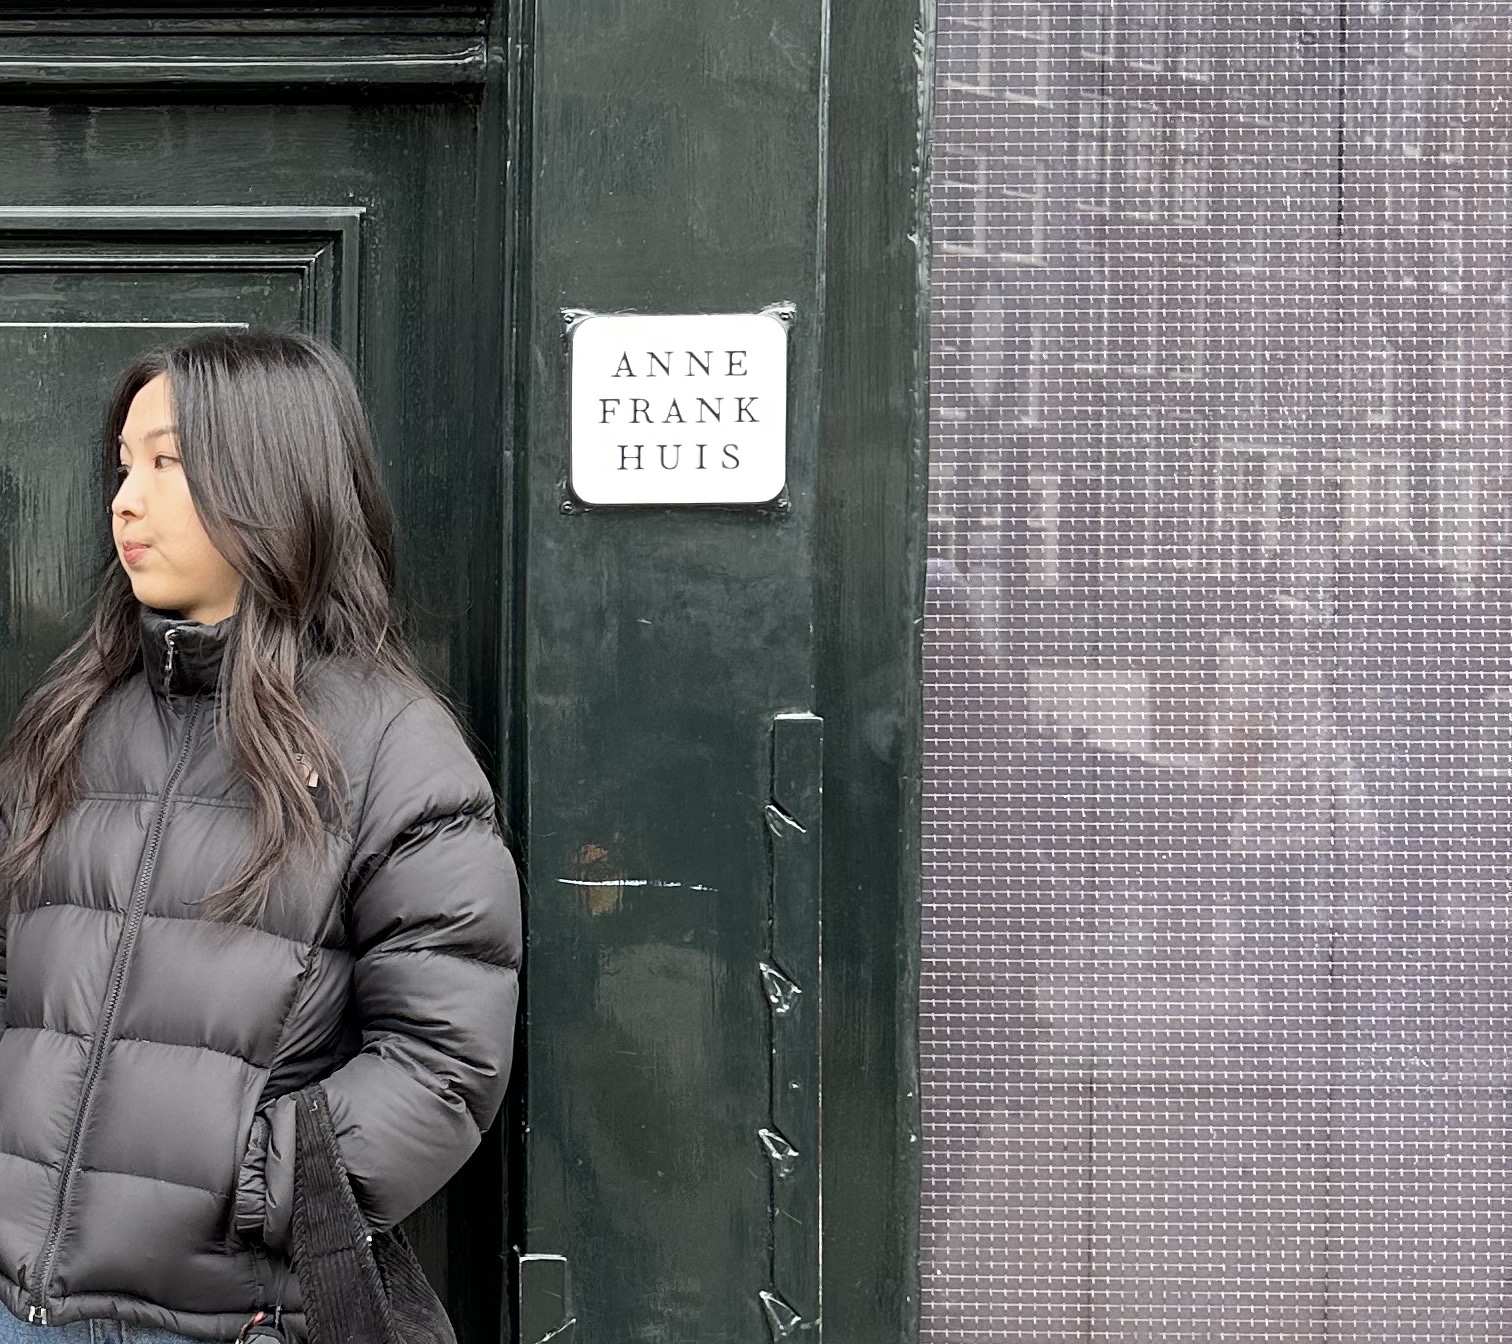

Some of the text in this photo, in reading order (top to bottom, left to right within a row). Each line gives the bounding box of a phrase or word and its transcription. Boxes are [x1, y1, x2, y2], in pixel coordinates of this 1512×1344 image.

[612, 351, 747, 377] ANNE
[599, 397, 759, 423] FRANK
[617, 444, 739, 470] HUIS
